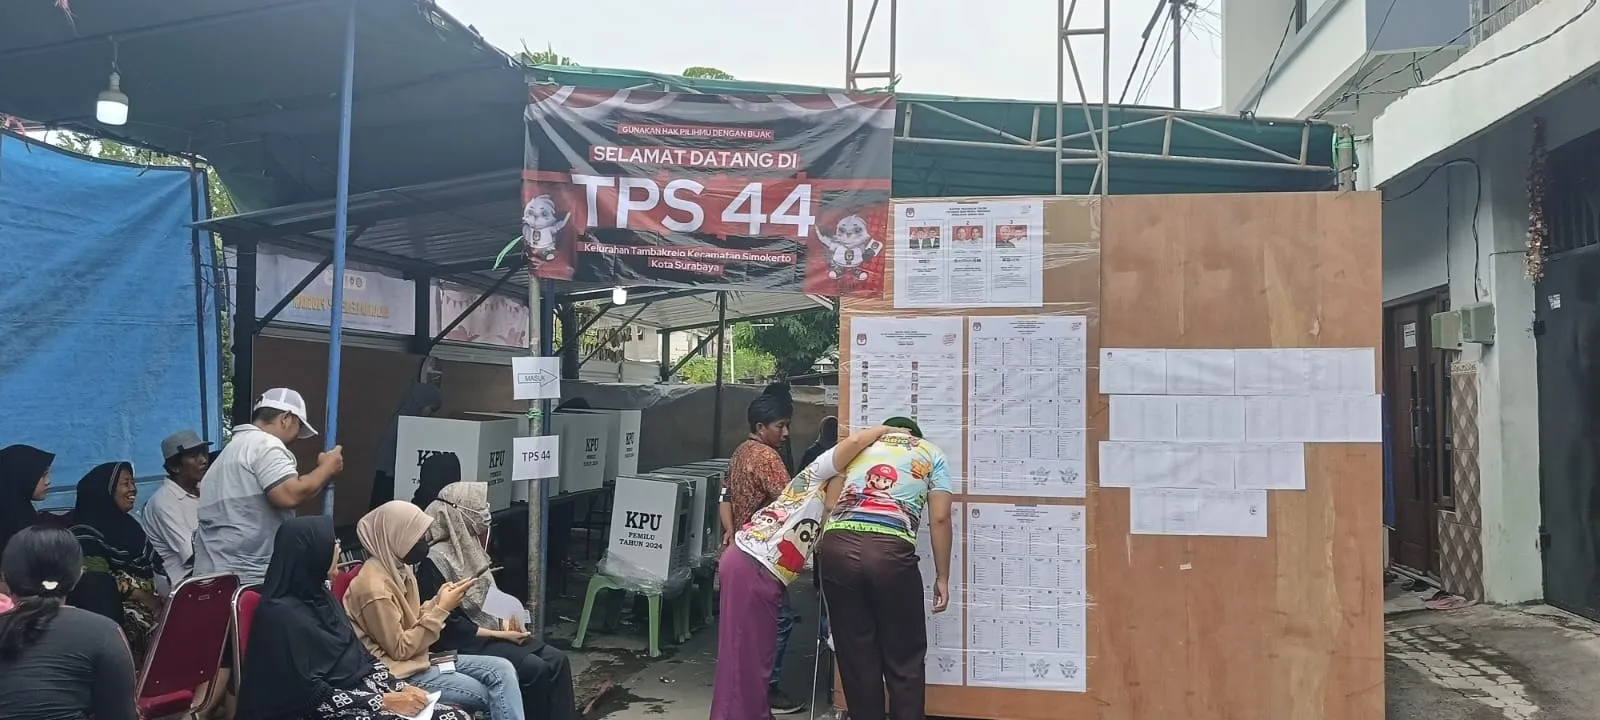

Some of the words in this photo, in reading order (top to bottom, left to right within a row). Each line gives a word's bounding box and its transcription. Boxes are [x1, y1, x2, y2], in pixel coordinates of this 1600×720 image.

[622, 126, 661, 135] GUNAKAN
[662, 128, 679, 136] HAK
[680, 128, 712, 137] PILIHMU
[713, 129, 746, 138] DENGAN
[747, 130, 772, 139] BIJAK
[593, 146, 686, 165] SELAMAT
[690, 150, 773, 168] DATANG
[778, 153, 798, 169] DI
[571, 174, 705, 233] TPS
[721, 182, 816, 237] 44
[584, 243, 630, 254] Kelurahan
[742, 253, 792, 262] Simokerto
[651, 259, 674, 269] Kota
[675, 260, 720, 272] Surabaya
[585, 438, 599, 452] KPU
[489, 450, 506, 468] KPU
[521, 451, 539, 462] TPS
[541, 450, 551, 461] 44
[624, 511, 663, 531] KPU
[628, 532, 656, 541] PEMILU
[619, 538, 643, 547] TAHUN
[645, 542, 663, 550] 2024
